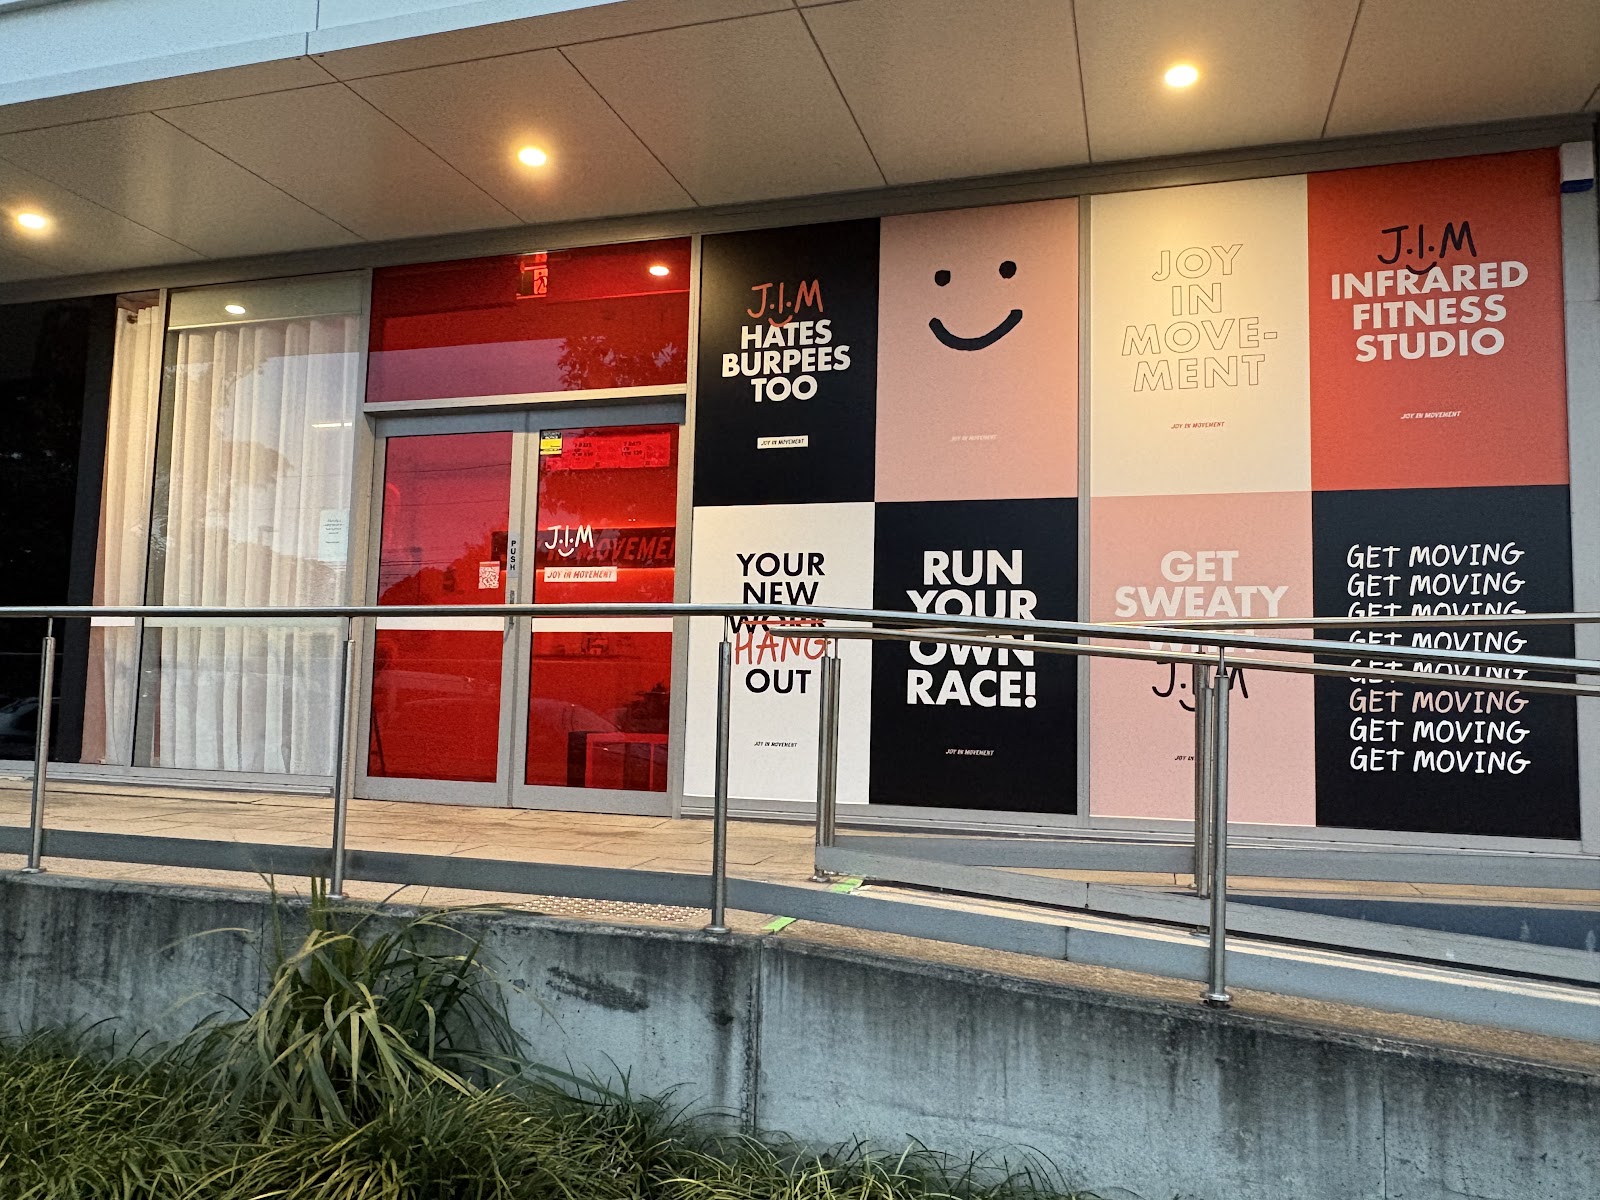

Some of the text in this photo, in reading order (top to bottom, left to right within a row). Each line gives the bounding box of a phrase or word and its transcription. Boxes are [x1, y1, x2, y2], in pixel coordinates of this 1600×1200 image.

[1377, 221, 1477, 264] J.I.M
[1151, 244, 1243, 281] JOY
[1331, 260, 1529, 300] INFRARED
[747, 280, 823, 318] J.I.M
[1171, 283, 1222, 316] IN
[1353, 294, 1507, 330] FITNESS
[741, 319, 832, 349] HATES
[1122, 317, 1278, 356] MOVE-
[1355, 327, 1505, 362] STUDIO
[722, 345, 851, 377] BURPEES
[1133, 354, 1265, 392] MENT
[751, 375, 818, 402] TOO
[1192, 421, 1225, 429] MOVEMENT
[1424, 410, 1461, 419] MOVEMENT
[544, 524, 594, 549] J.I.M
[509, 540, 517, 571] PUSH
[736, 552, 825, 577] YOUR
[923, 550, 1023, 586] RUN
[1160, 550, 1239, 582] GET
[1346, 541, 1526, 570] GET MOVING
[547, 570, 613, 579] JOY IN MOVEMENT
[1347, 571, 1526, 598] GET MOVING
[743, 581, 819, 605] NEW
[906, 588, 1038, 621] YOUR
[1114, 585, 1289, 618] SWEATY
[735, 632, 832, 665] HANG
[909, 634, 1035, 667] OWN
[1411, 630, 1528, 654] MOVING
[745, 668, 811, 694] OUT
[907, 669, 1037, 709] RACE!
[1349, 687, 1530, 715] GET MOVING
[1350, 716, 1531, 745] GET MOVING
[964, 749, 995, 757] MOVEMENT
[1350, 746, 1532, 775] GET MOVING
